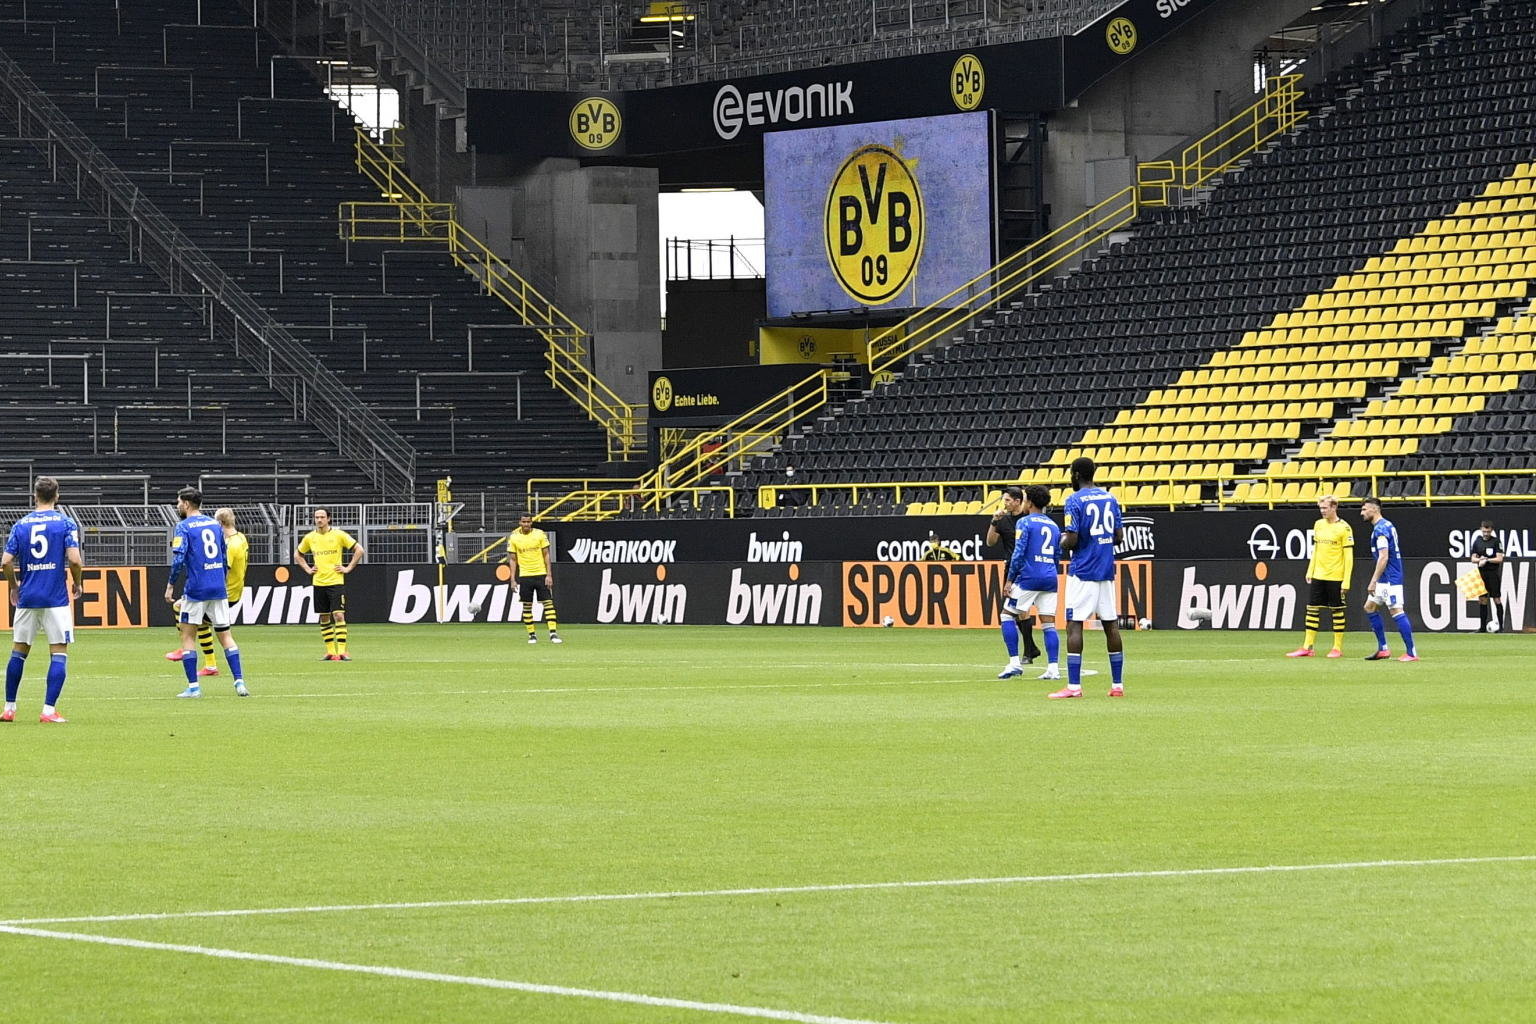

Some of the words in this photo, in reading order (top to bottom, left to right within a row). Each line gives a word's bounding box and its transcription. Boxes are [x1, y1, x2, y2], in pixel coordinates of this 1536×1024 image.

[1109, 21, 1134, 47] BVB
[1121, 39, 1131, 50] 09
[955, 61, 981, 95] BVB
[963, 93, 974, 105] 09
[577, 103, 616, 134] BVB
[588, 133, 603, 144] 09
[839, 162, 913, 257] BVB
[861, 254, 889, 287] 09
[655, 380, 671, 401] BVB
[674, 394, 695, 407] Echte
[696, 393, 720, 406] Liebe.
[1086, 501, 1115, 536] 26
[30, 524, 49, 559] 5
[201, 528, 219, 559] 8
[747, 531, 803, 563] bwin
[1040, 526, 1054, 555] 2
[596, 564, 687, 623] bwin
[725, 563, 823, 625] bwin
[1177, 561, 1297, 630] bwin
